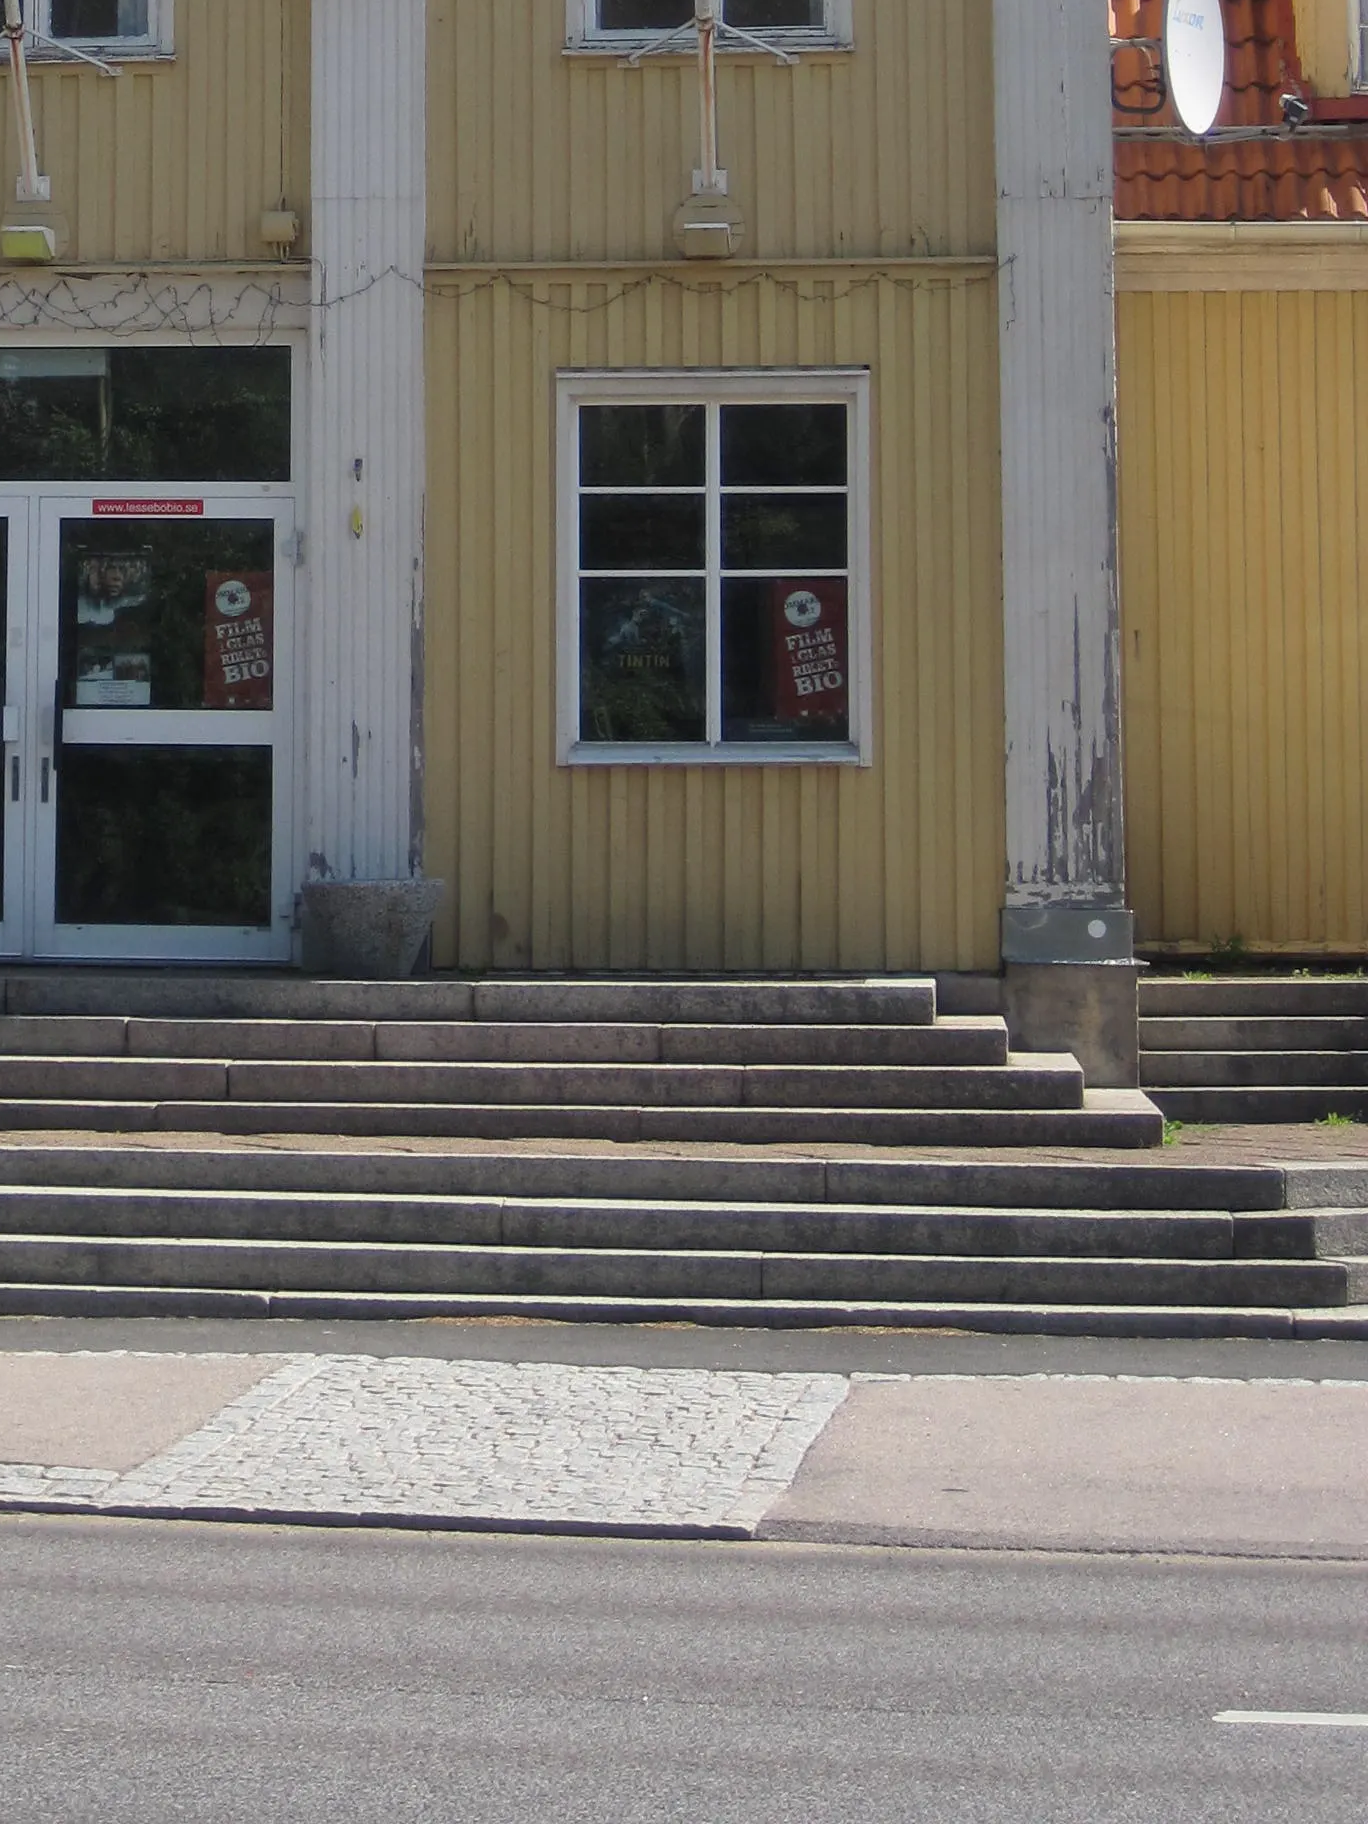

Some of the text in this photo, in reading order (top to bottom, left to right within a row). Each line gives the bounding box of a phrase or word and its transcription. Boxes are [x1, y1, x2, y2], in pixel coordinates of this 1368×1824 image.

[97, 502, 199, 514] www.lessebobio.se
[215, 617, 263, 639] FILM
[785, 627, 834, 651] FILM
[222, 659, 270, 684] BIO
[618, 654, 670, 668] TINTIN
[794, 670, 843, 697] BIO
